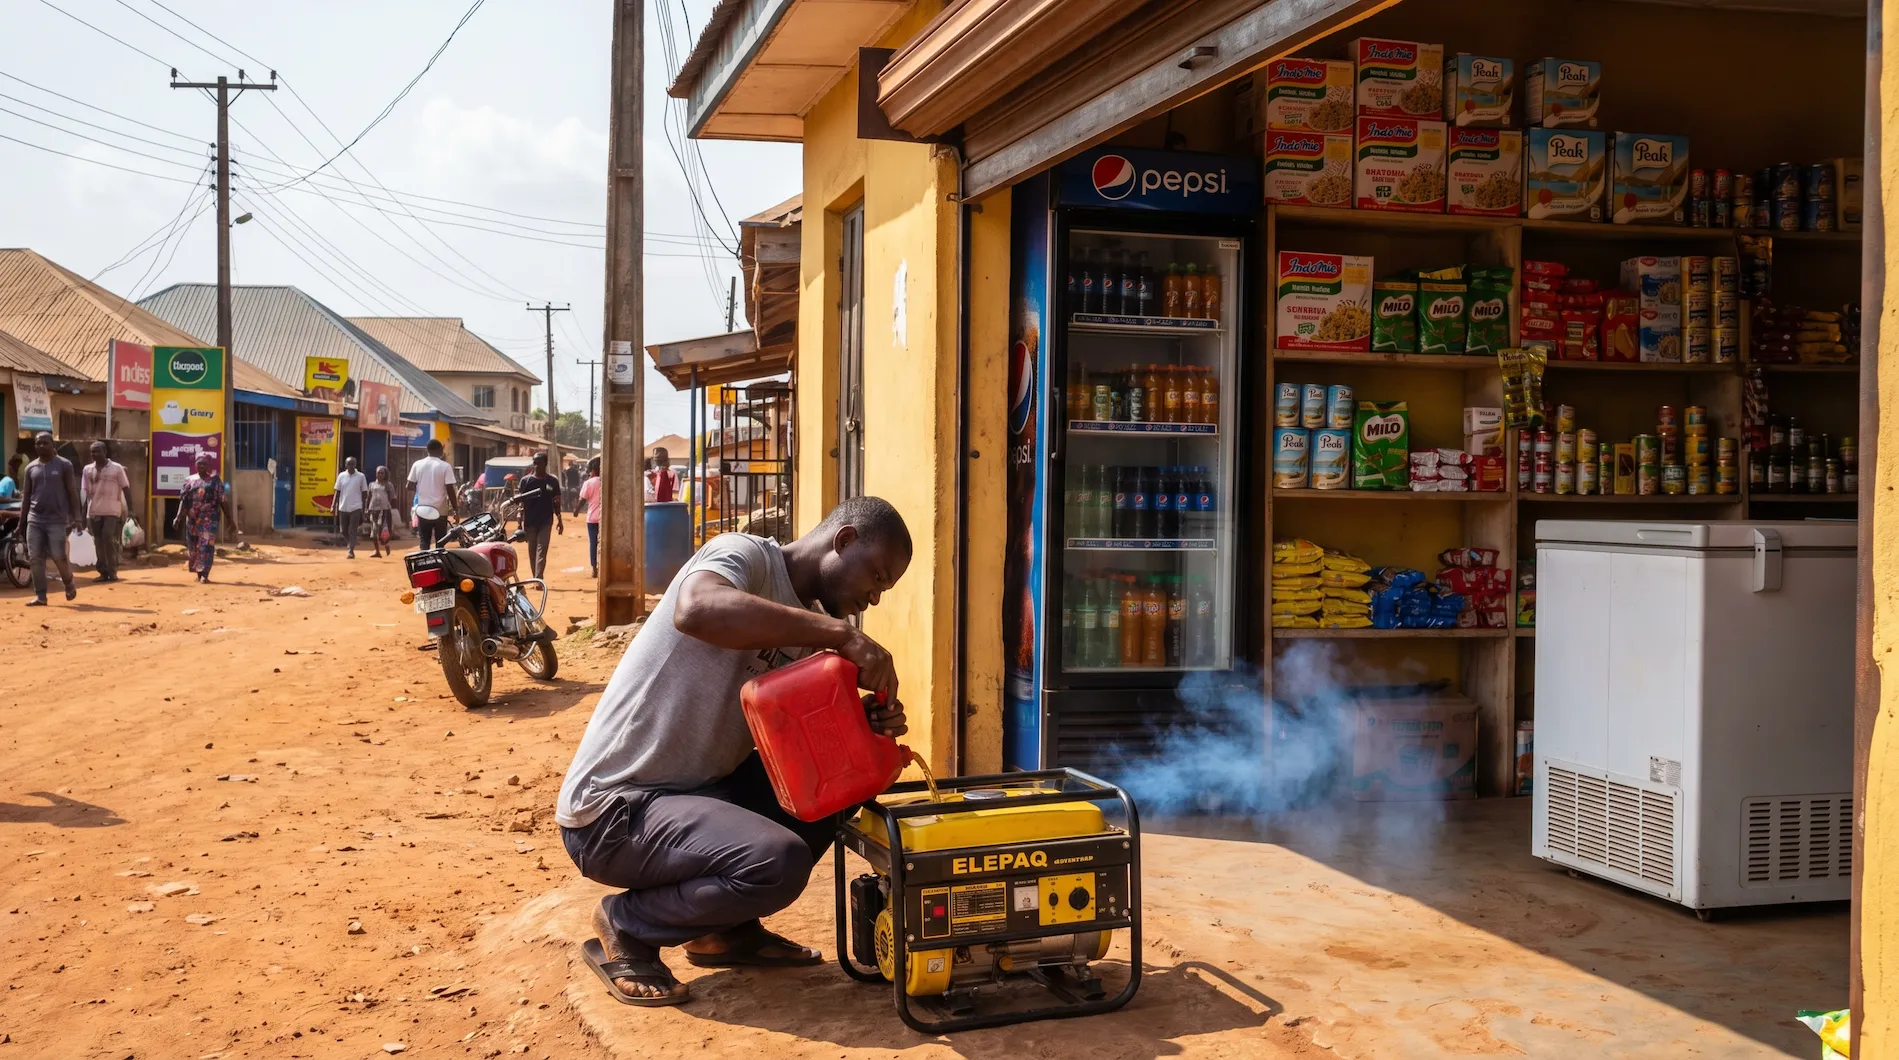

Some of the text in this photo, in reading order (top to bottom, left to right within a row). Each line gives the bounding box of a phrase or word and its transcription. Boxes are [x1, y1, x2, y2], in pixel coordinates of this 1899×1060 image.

[1560, 65, 1586, 81] Peak
[1550, 137, 1584, 158] Peak
[1635, 141, 1668, 162] Peak
[1141, 168, 1226, 198] pepsi
[1383, 301, 1411, 313] MILO
[1432, 303, 1461, 315] MILO
[1474, 305, 1501, 317] MILO
[1367, 422, 1401, 437] MILO
[1282, 434, 1304, 448] Peak
[1320, 434, 1342, 449] Peak
[952, 850, 1048, 875] ELEPAQ
